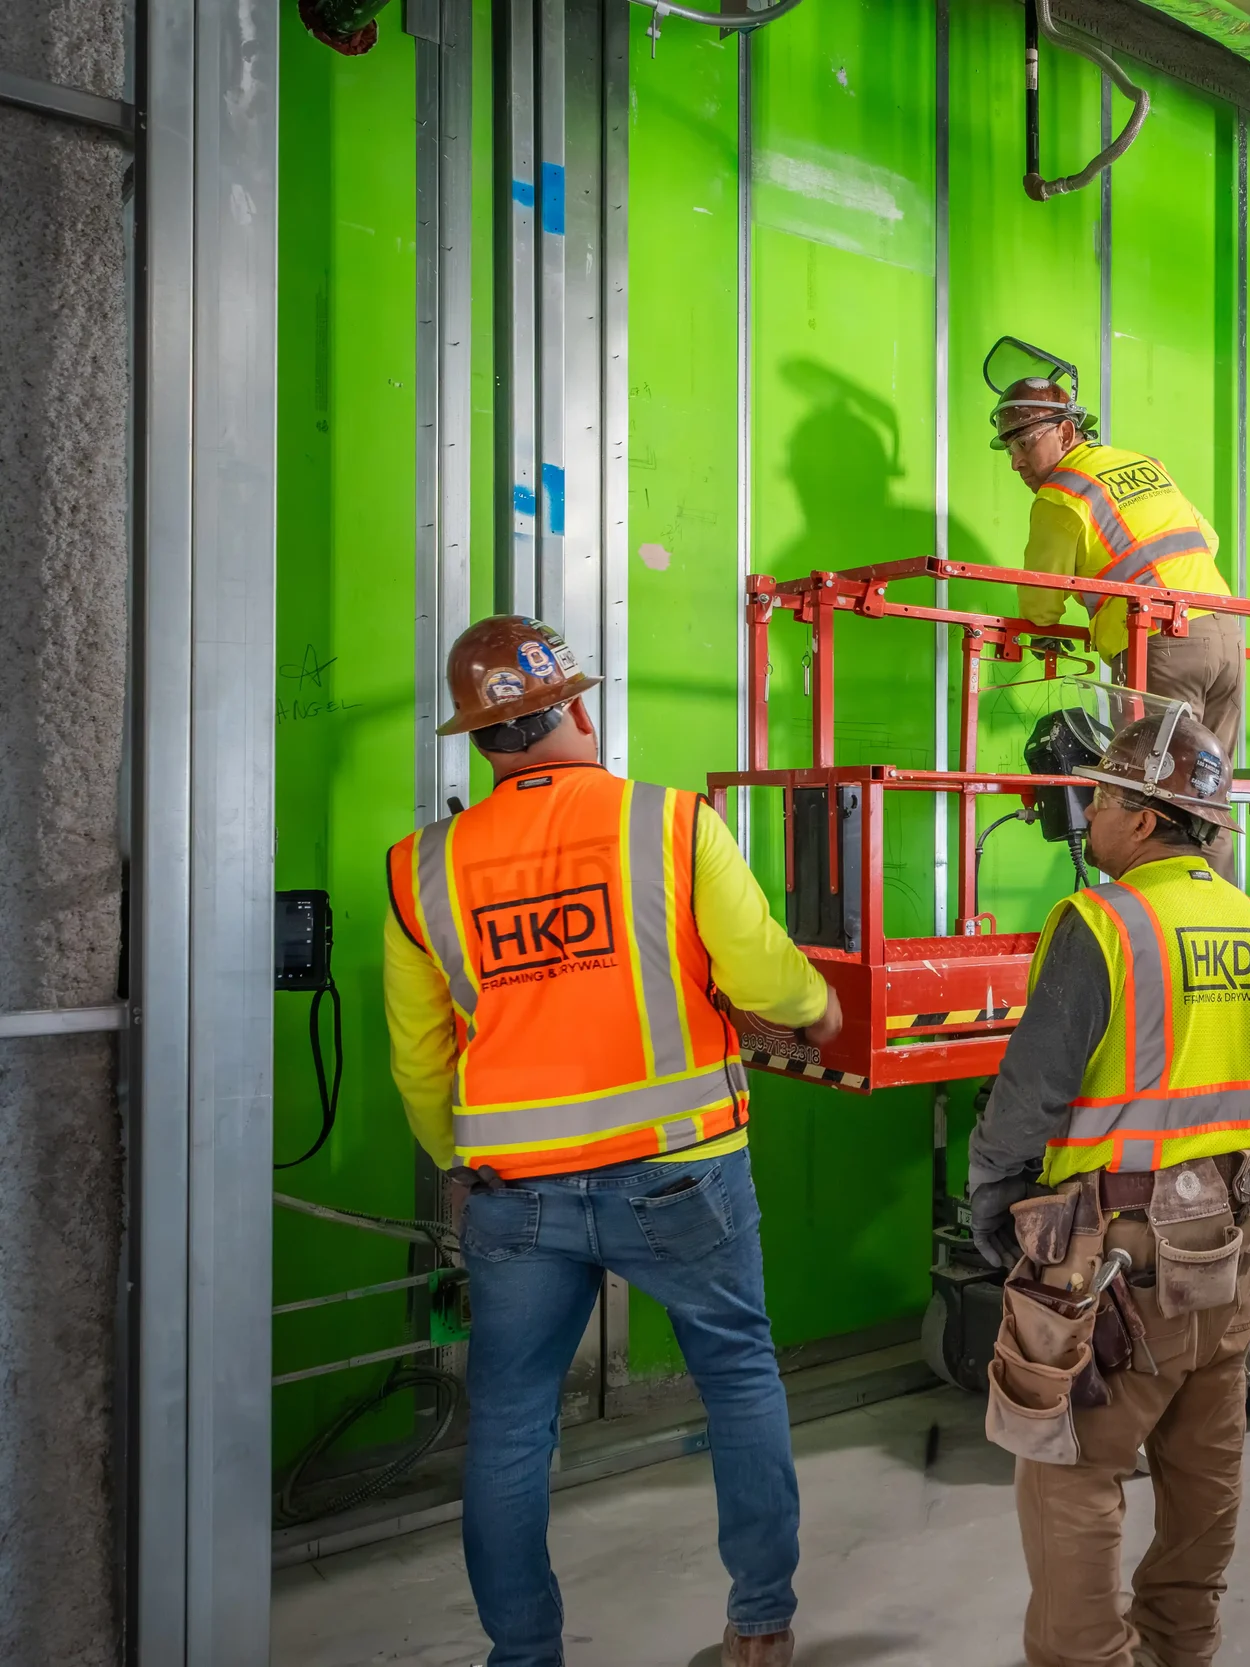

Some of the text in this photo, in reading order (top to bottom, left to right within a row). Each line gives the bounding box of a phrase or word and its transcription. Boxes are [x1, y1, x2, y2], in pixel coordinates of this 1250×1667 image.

[1108, 466, 1160, 495] HKD
[1118, 493, 1149, 511] FRAMING
[276, 698, 363, 724] ANGEL
[487, 902, 596, 961] HKD
[481, 970, 545, 994] FRAMING
[548, 968, 558, 979] &
[1216, 993, 1222, 1002] &
[741, 1031, 821, 1065] 909-713-2318
